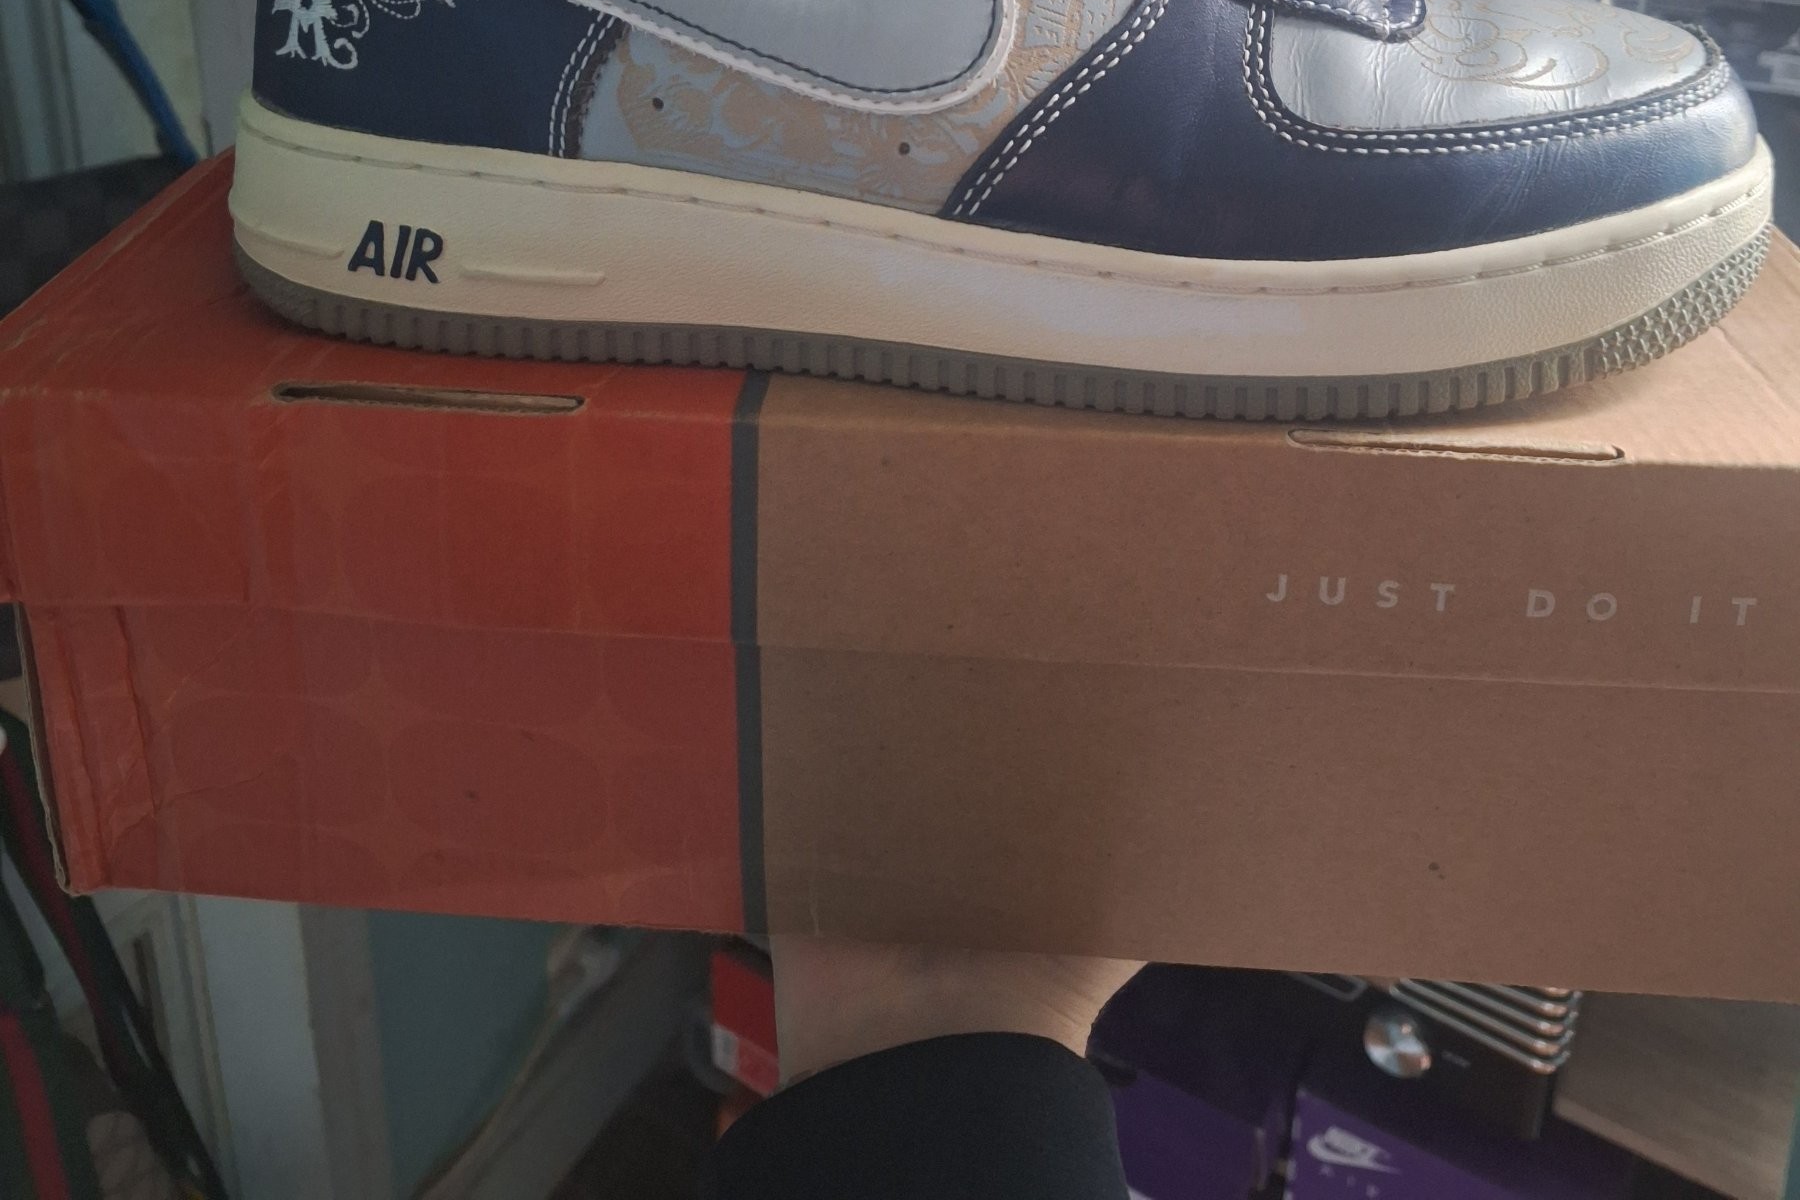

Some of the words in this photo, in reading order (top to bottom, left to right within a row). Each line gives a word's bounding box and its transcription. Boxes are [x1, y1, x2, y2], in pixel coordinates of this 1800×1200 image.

[347, 219, 444, 284] AIR
[1266, 573, 1455, 613] JUST
[1525, 588, 1618, 622] DO
[1689, 596, 1758, 627] IT
